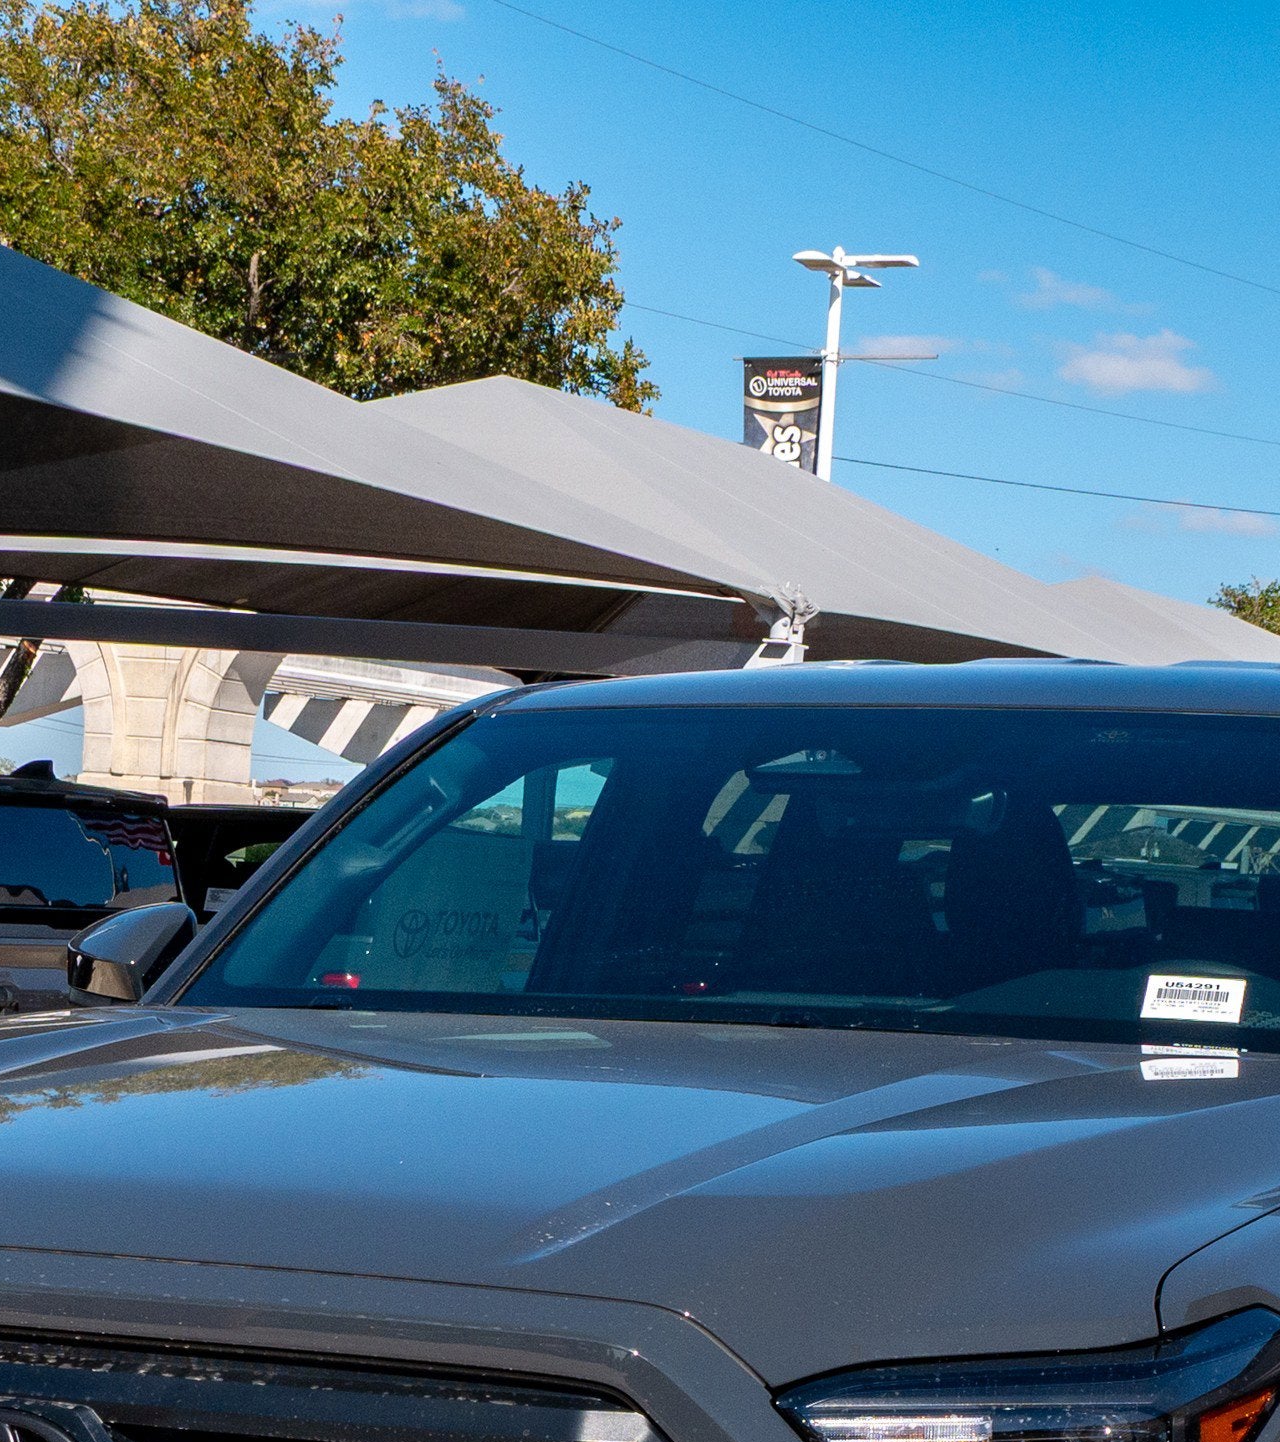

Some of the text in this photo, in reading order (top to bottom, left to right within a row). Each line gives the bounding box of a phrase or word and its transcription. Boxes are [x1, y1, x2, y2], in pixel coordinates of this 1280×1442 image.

[767, 377, 818, 386] UNIVERSAL
[768, 387, 802, 396] TOYOTA
[1165, 981, 1221, 990] U54291
